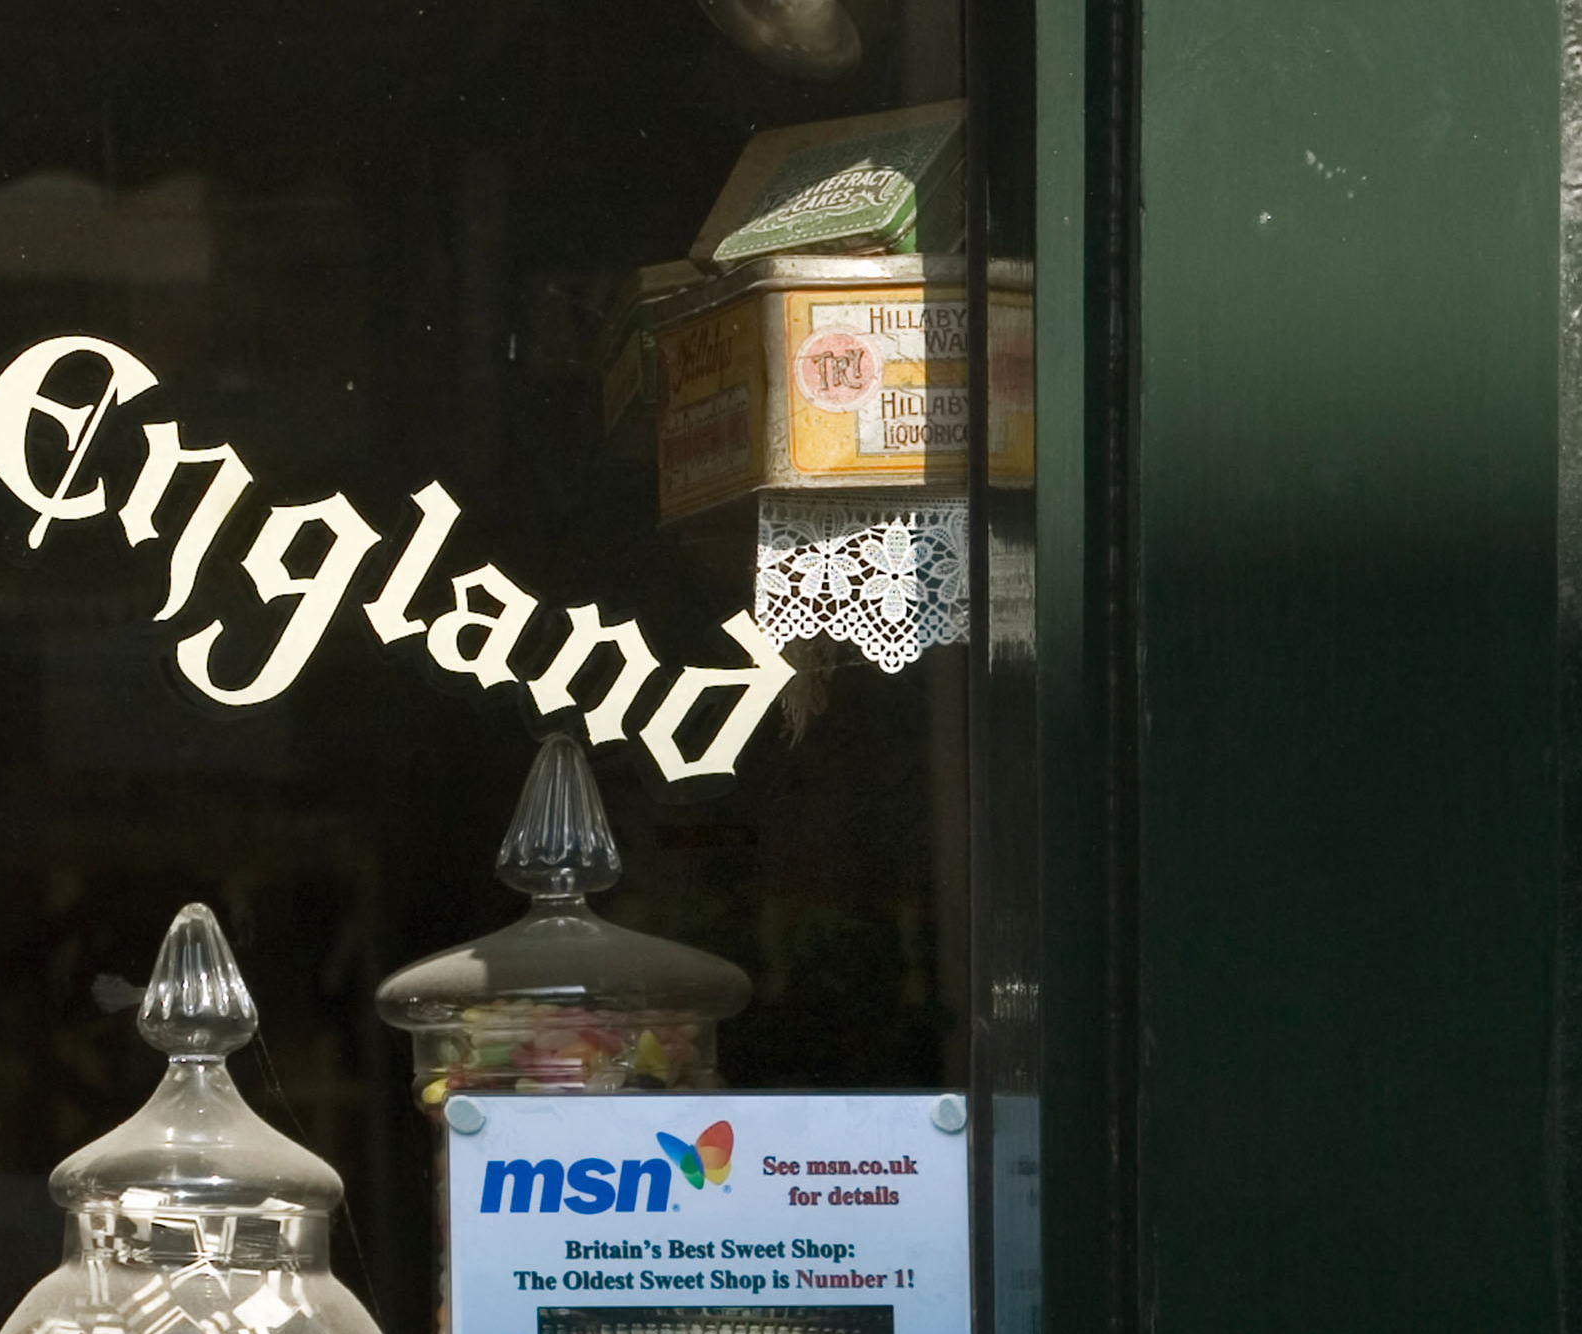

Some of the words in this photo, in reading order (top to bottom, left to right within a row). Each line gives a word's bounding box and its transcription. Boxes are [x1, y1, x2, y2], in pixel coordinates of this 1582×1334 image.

[792, 189, 851, 213] CAKES
[812, 349, 865, 393] TRY
[762, 1156, 800, 1176] See
[806, 1155, 918, 1176] msn.co.uk
[480, 1157, 672, 1215] msn
[788, 1186, 821, 1206] for
[827, 1186, 899, 1206] details
[564, 1241, 661, 1258] Britain's
[669, 1241, 714, 1258] Best
[721, 1241, 784, 1258] Sweet
[792, 1241, 856, 1263] Shop:
[513, 1271, 556, 1288] The
[563, 1271, 633, 1288] Oldest
[640, 1271, 704, 1288] Sweet
[711, 1271, 765, 1292] Shop
[773, 1271, 789, 1288] is
[797, 1271, 886, 1288] Number
[897, 1271, 917, 1288] 1!
